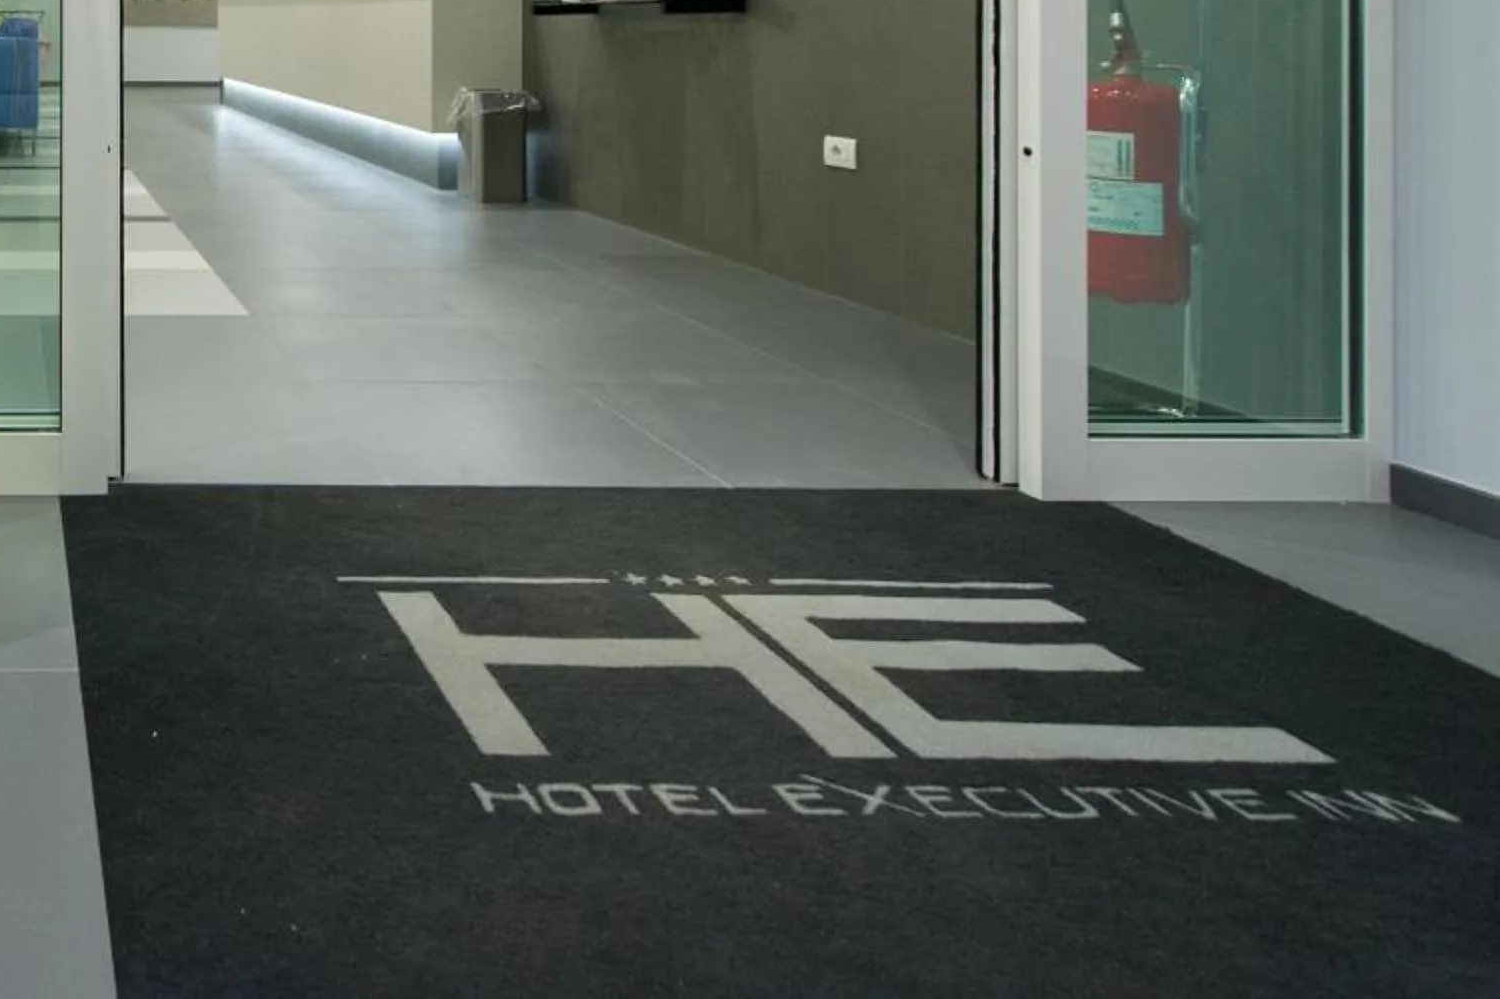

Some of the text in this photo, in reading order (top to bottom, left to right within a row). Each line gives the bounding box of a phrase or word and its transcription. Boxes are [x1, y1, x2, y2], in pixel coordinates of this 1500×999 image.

[378, 591, 1337, 762] HE
[470, 774, 1463, 824] HOTEL EXECUTIVE INN
